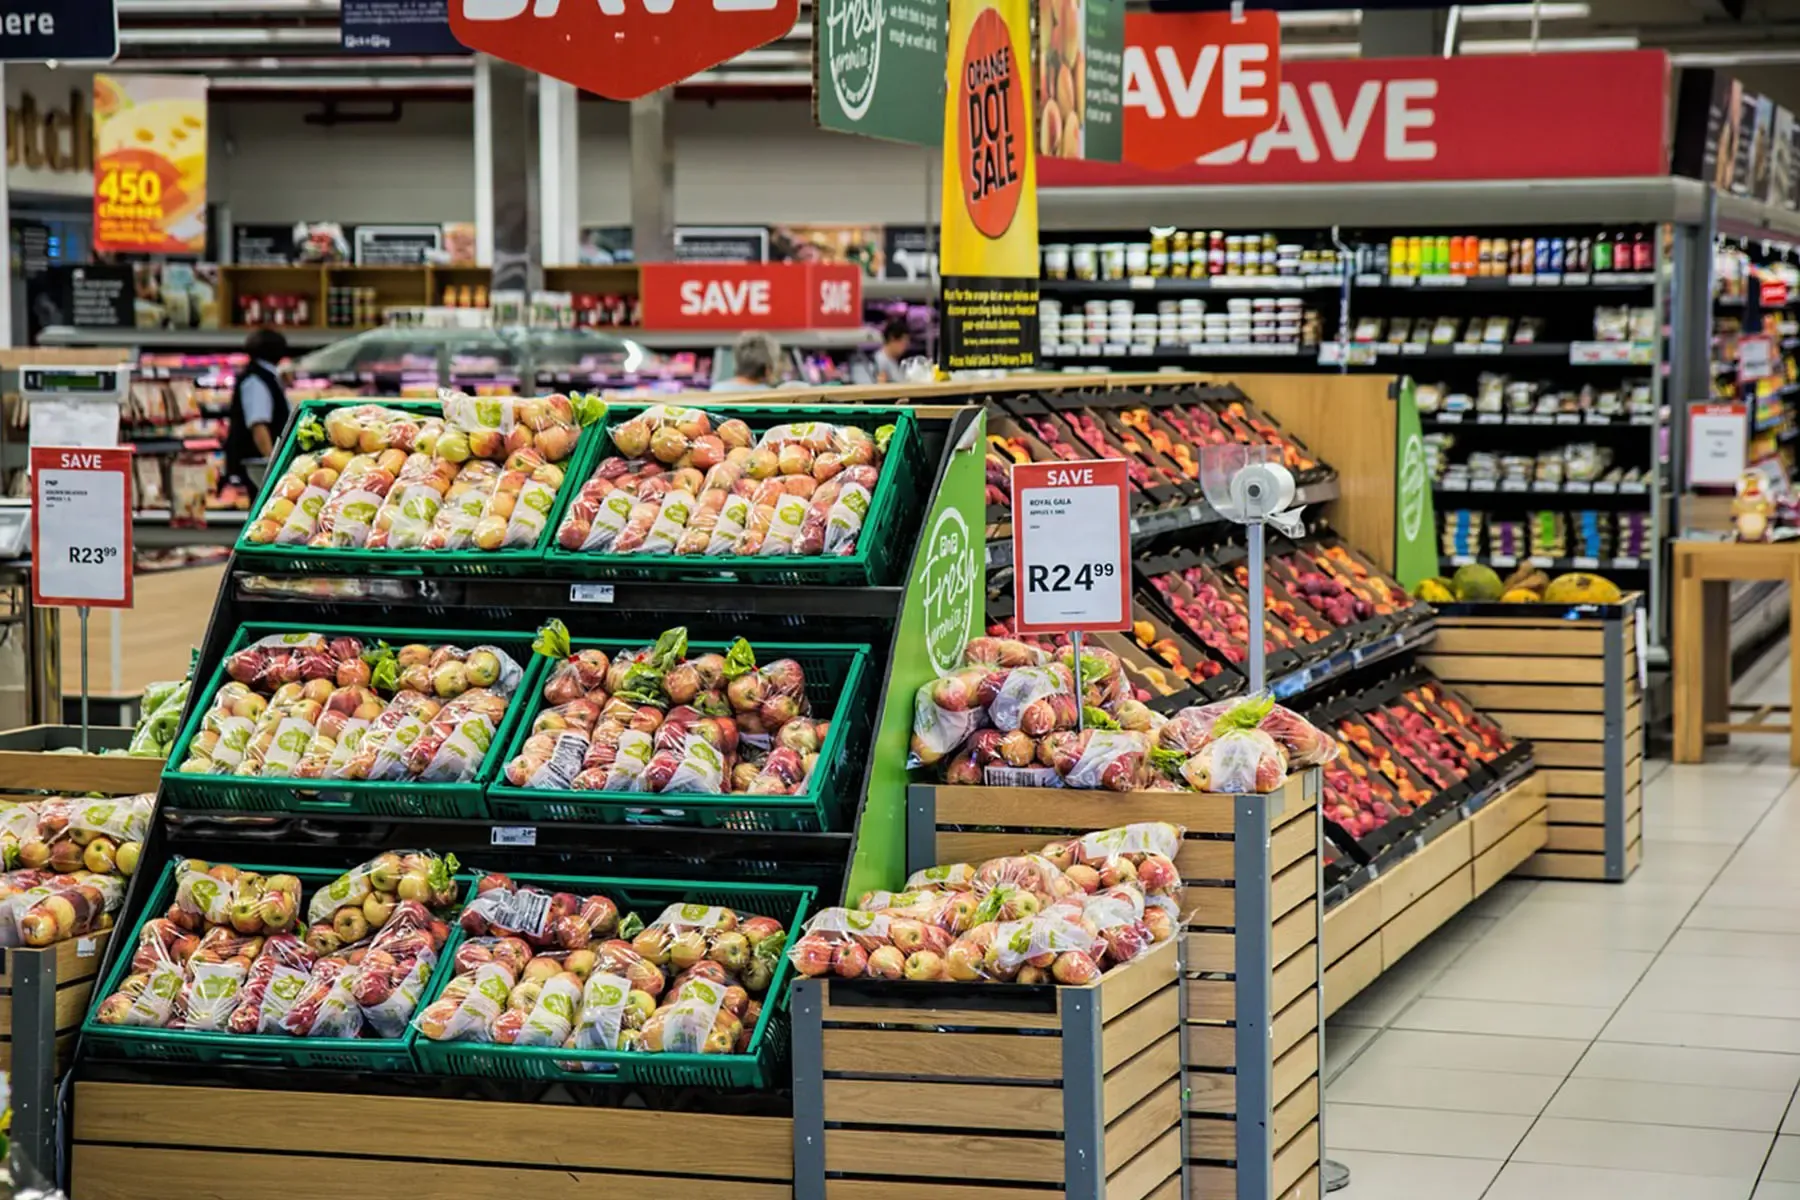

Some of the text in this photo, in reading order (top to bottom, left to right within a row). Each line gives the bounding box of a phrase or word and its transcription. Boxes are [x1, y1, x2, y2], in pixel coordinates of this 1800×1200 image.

[967, 47, 1010, 91] ORANGE
[969, 79, 1010, 150] DOT
[1196, 79, 1439, 165] AVE
[98, 168, 162, 206] 450
[971, 133, 1018, 201] SALE
[680, 280, 772, 316] SAVE
[61, 453, 102, 469] SAVE
[1047, 468, 1094, 485] SAVE
[1053, 498, 1072, 506] GALA
[919, 536, 979, 618] Fresh
